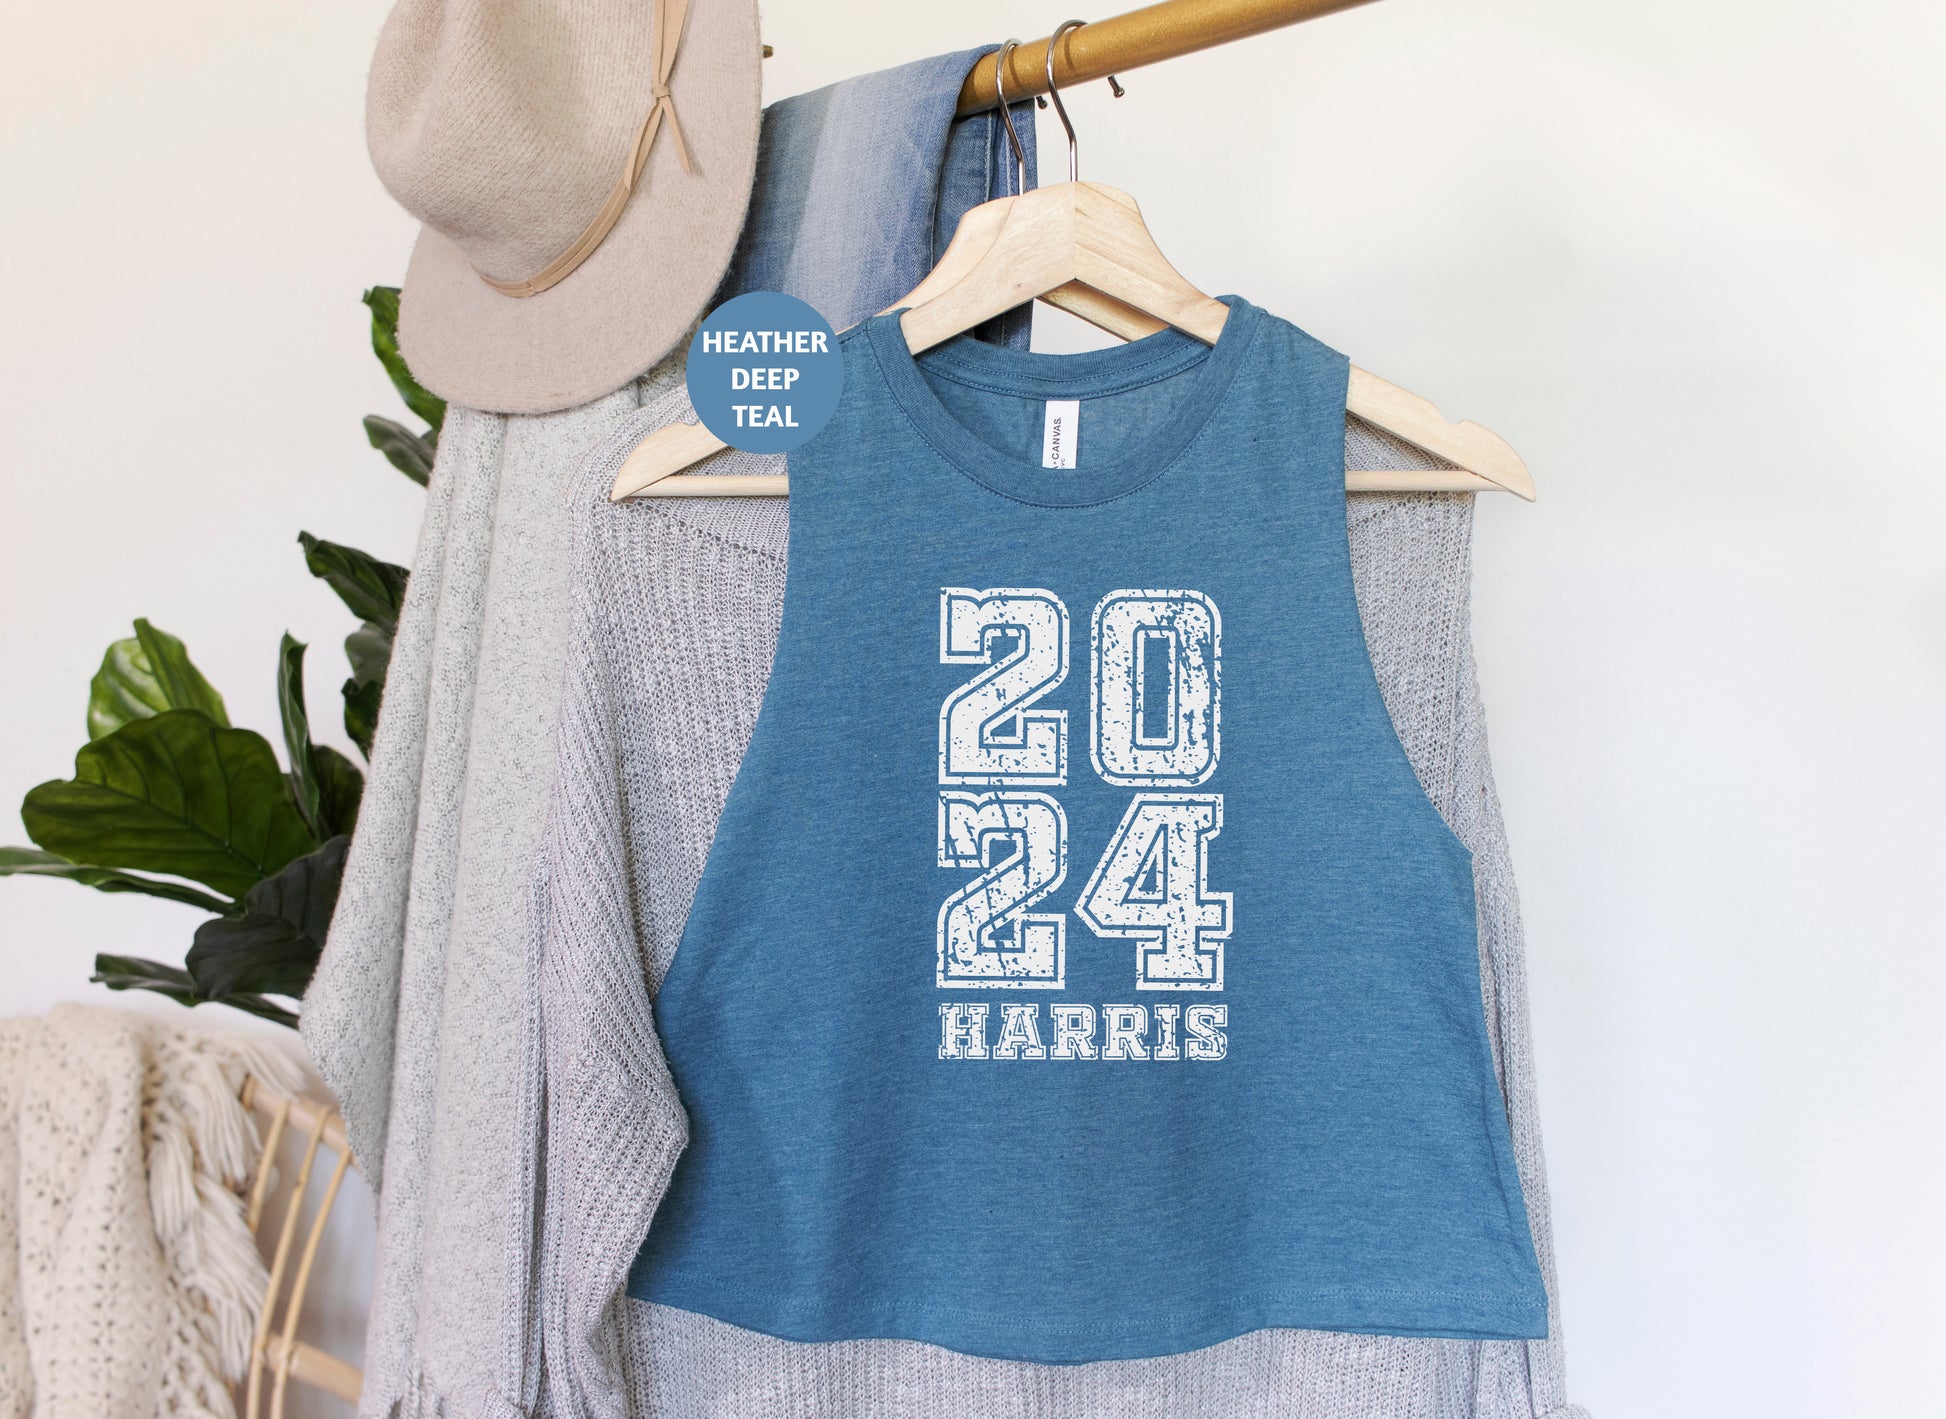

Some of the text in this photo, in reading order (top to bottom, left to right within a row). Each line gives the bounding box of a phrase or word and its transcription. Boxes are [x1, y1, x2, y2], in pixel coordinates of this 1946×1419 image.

[938, 587, 1222, 787] 20
[936, 791, 1234, 991] 24
[938, 1003, 1228, 1061] HARRIS
